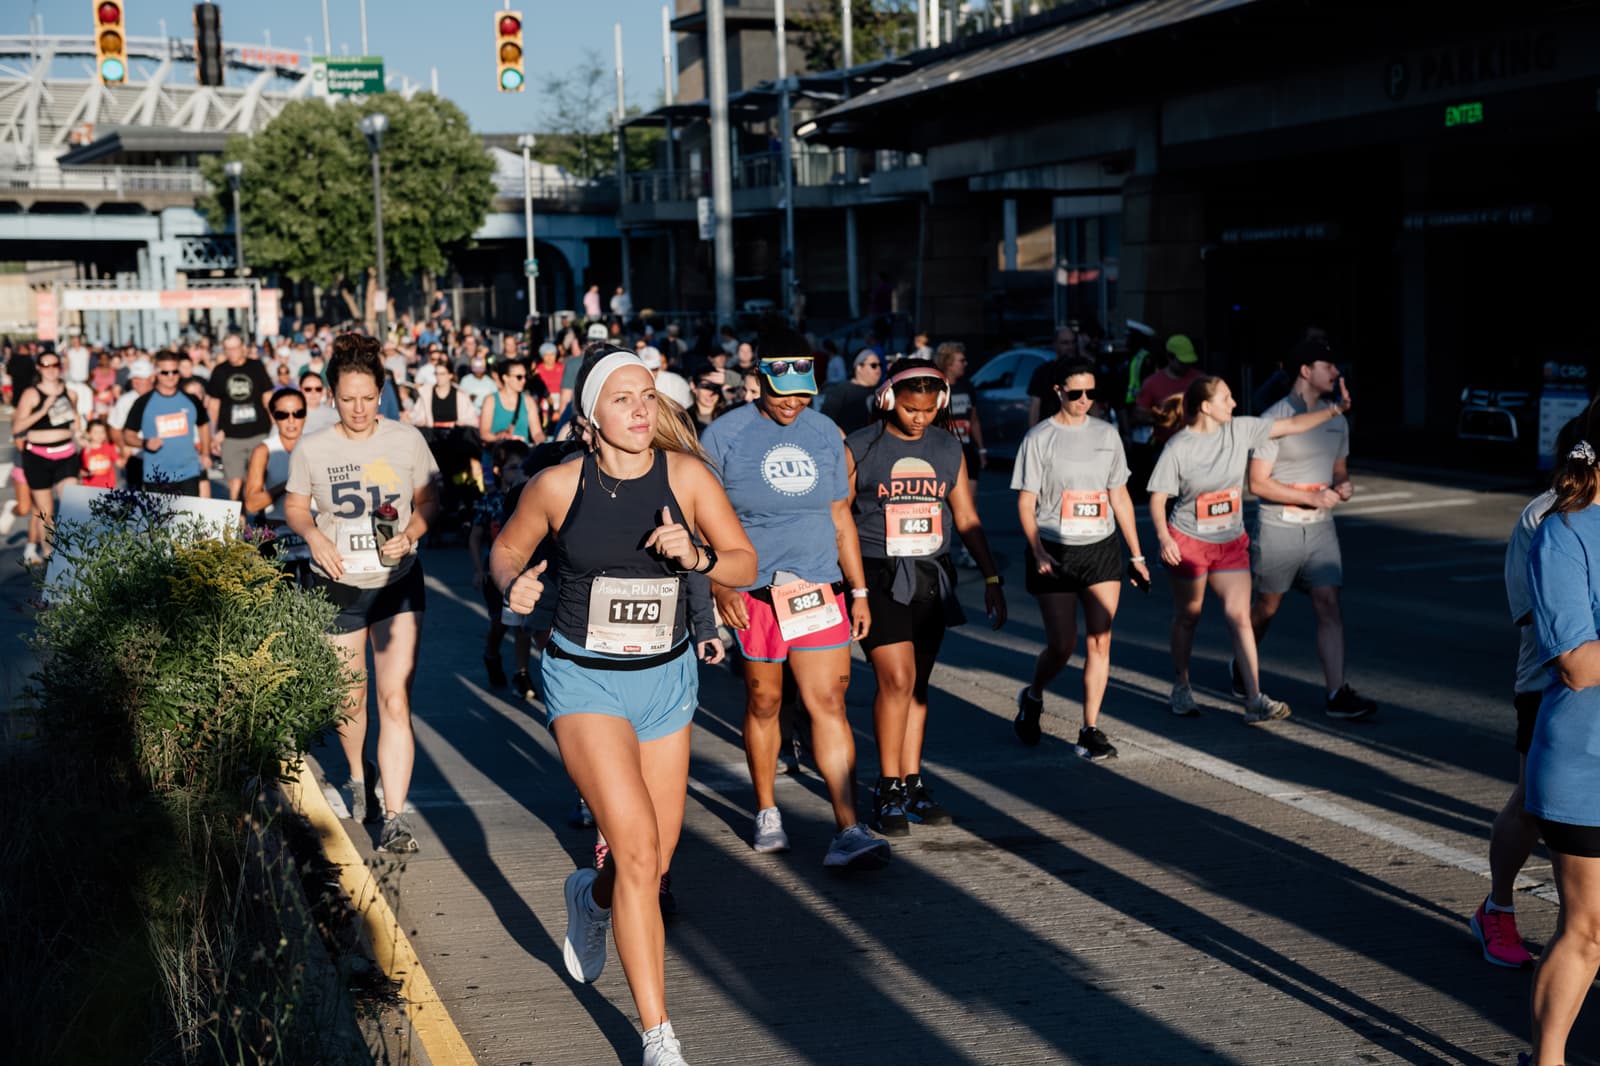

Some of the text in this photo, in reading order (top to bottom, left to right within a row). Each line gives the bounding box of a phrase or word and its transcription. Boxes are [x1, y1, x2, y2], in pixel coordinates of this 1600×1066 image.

[328, 81, 364, 91] Garage
[1445, 103, 1482, 126] ENTER
[327, 464, 360, 475] turtle
[765, 460, 815, 478] RUN
[329, 473, 349, 482] trot
[903, 519, 929, 533] 443
[351, 535, 377, 550] 113
[632, 584, 660, 596] RUN
[662, 586, 673, 594] 10K
[794, 592, 820, 611] 382
[612, 602, 660, 620] 1179
